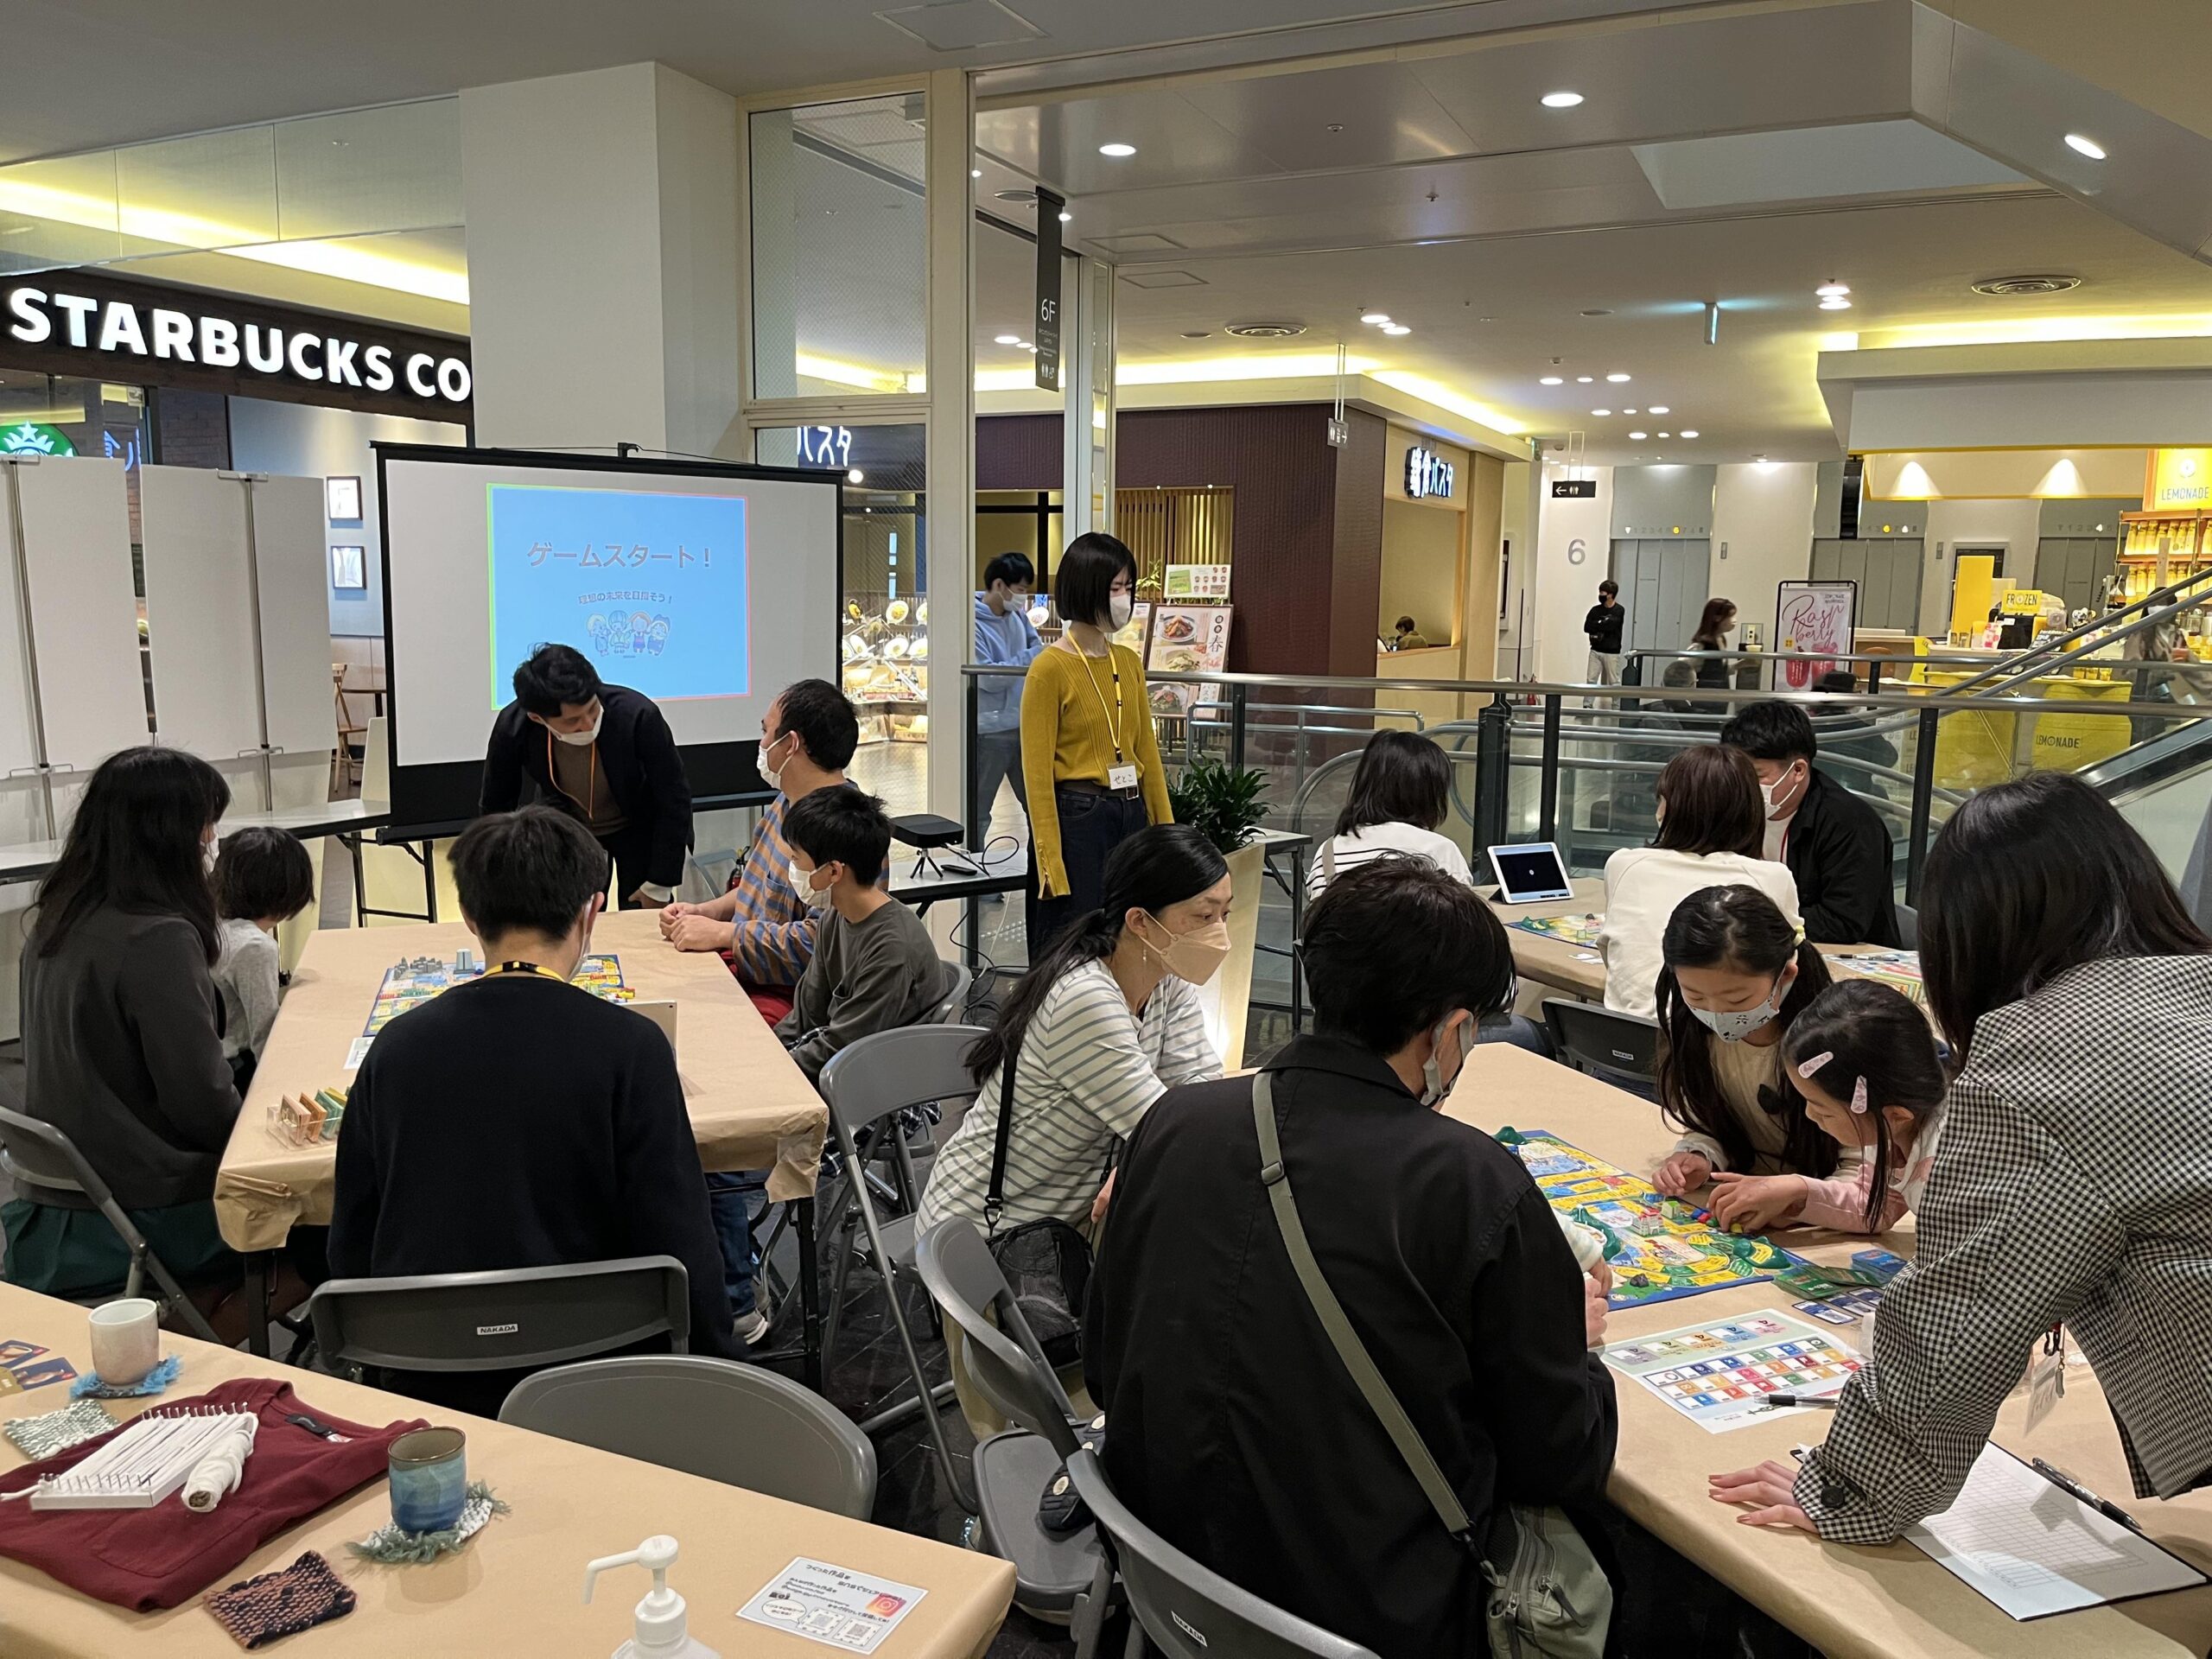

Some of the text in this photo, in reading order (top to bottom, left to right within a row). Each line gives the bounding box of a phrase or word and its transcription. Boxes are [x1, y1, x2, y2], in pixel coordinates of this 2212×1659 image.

[1041, 298, 1056, 321] 6F
[10, 287, 472, 402] STARBUCKS CO
[2161, 486, 2209, 500] LEMONADE
[526, 541, 710, 568] ゲームスタート！
[1567, 539, 1586, 565] 6
[2005, 593, 2037, 606] FROZEN
[2036, 734, 2081, 748] LEMONADE
[480, 1325, 516, 1334] NAKADA
